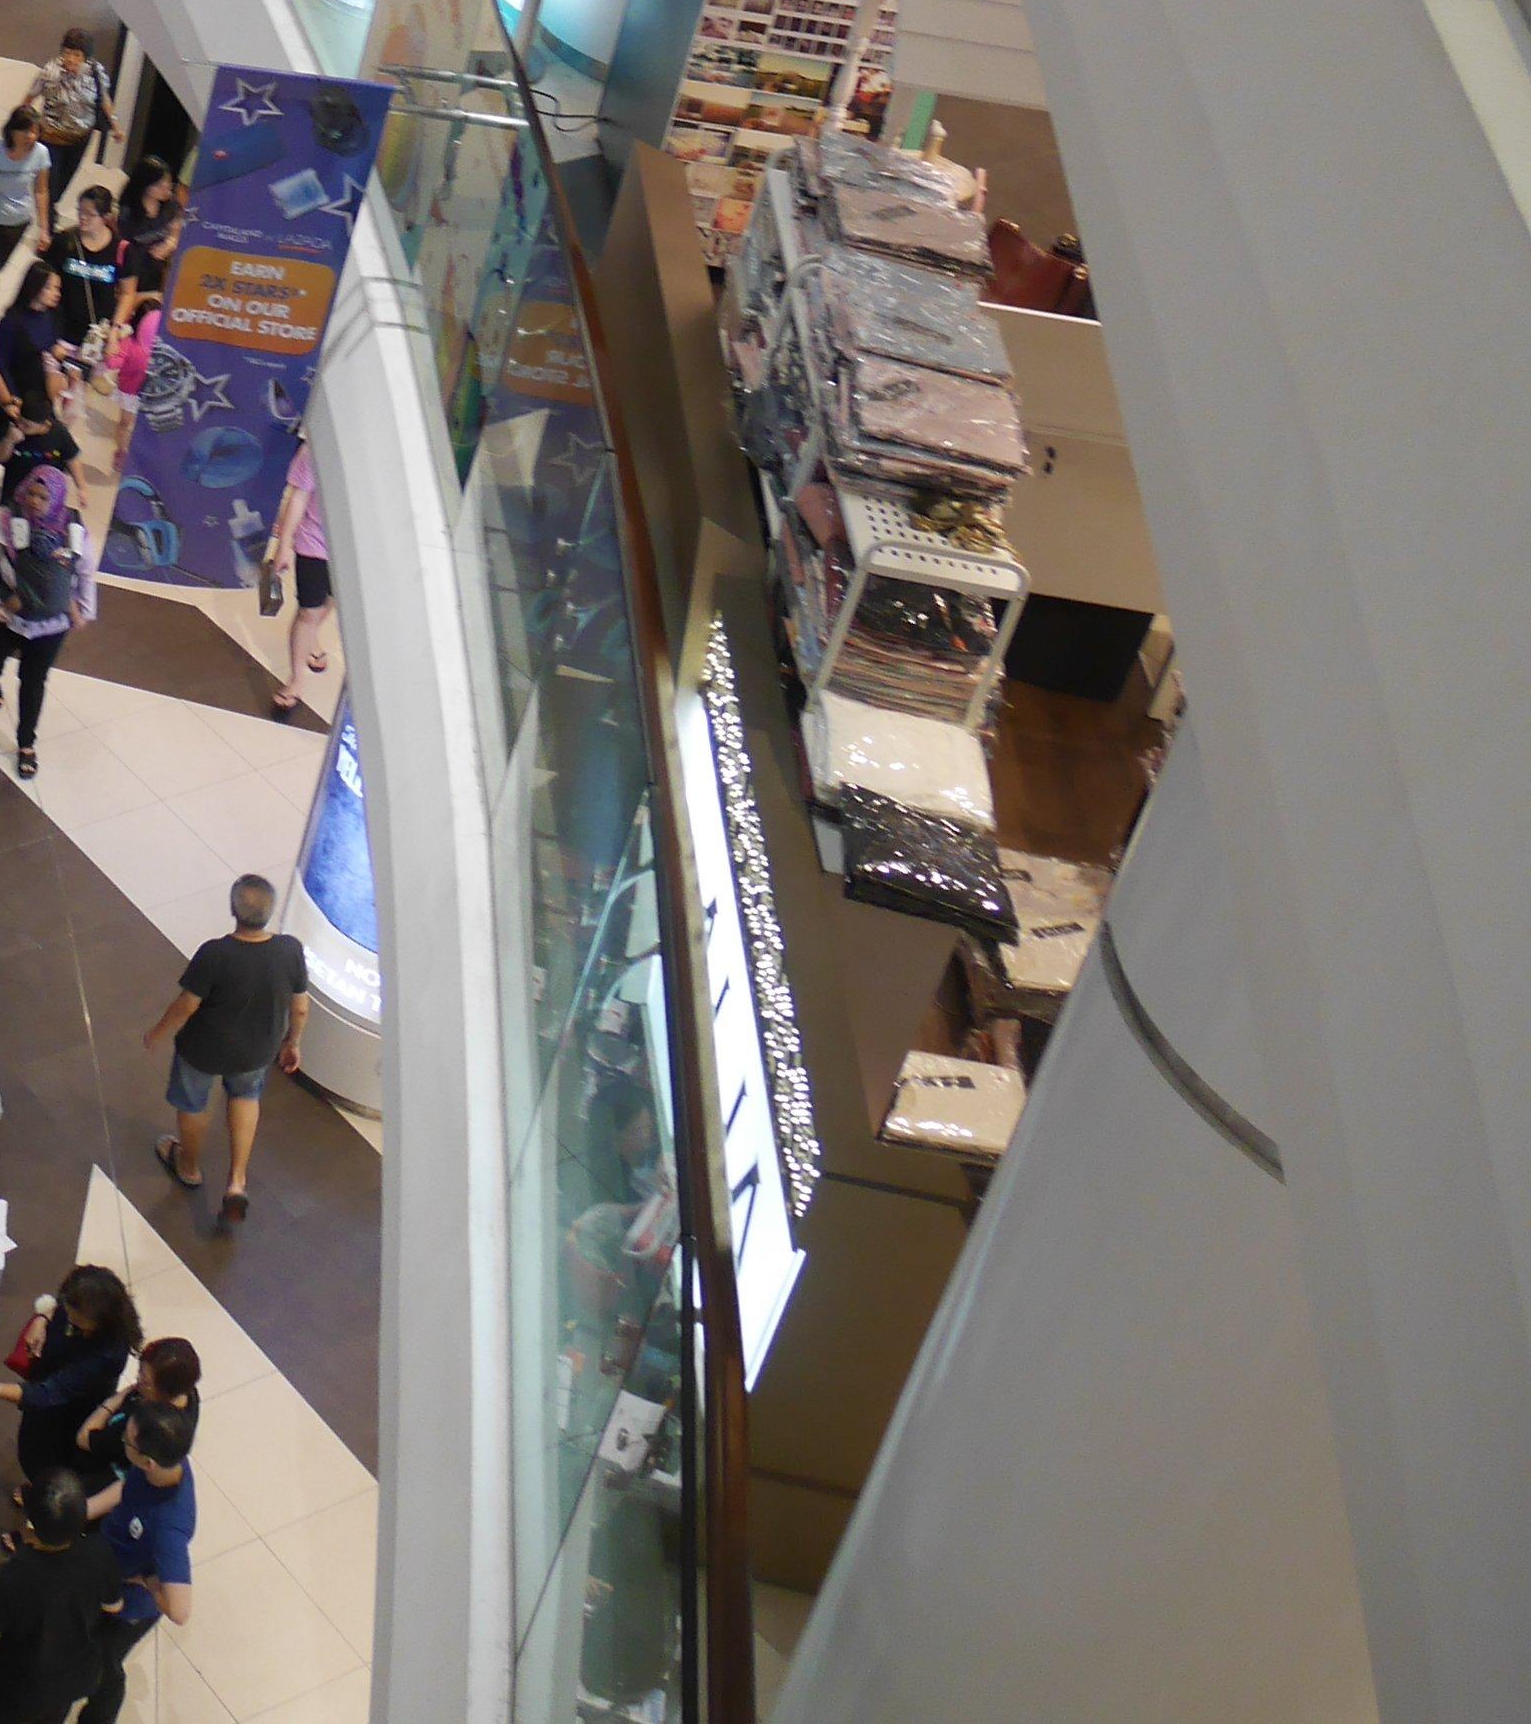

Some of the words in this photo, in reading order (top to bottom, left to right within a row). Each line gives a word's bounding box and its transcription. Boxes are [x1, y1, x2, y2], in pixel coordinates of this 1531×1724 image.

[229, 261, 286, 280] EARN
[207, 294, 243, 312] ON
[245, 299, 291, 319] OUR
[170, 307, 254, 332] OFFICIAL
[257, 319, 318, 340] STORE
